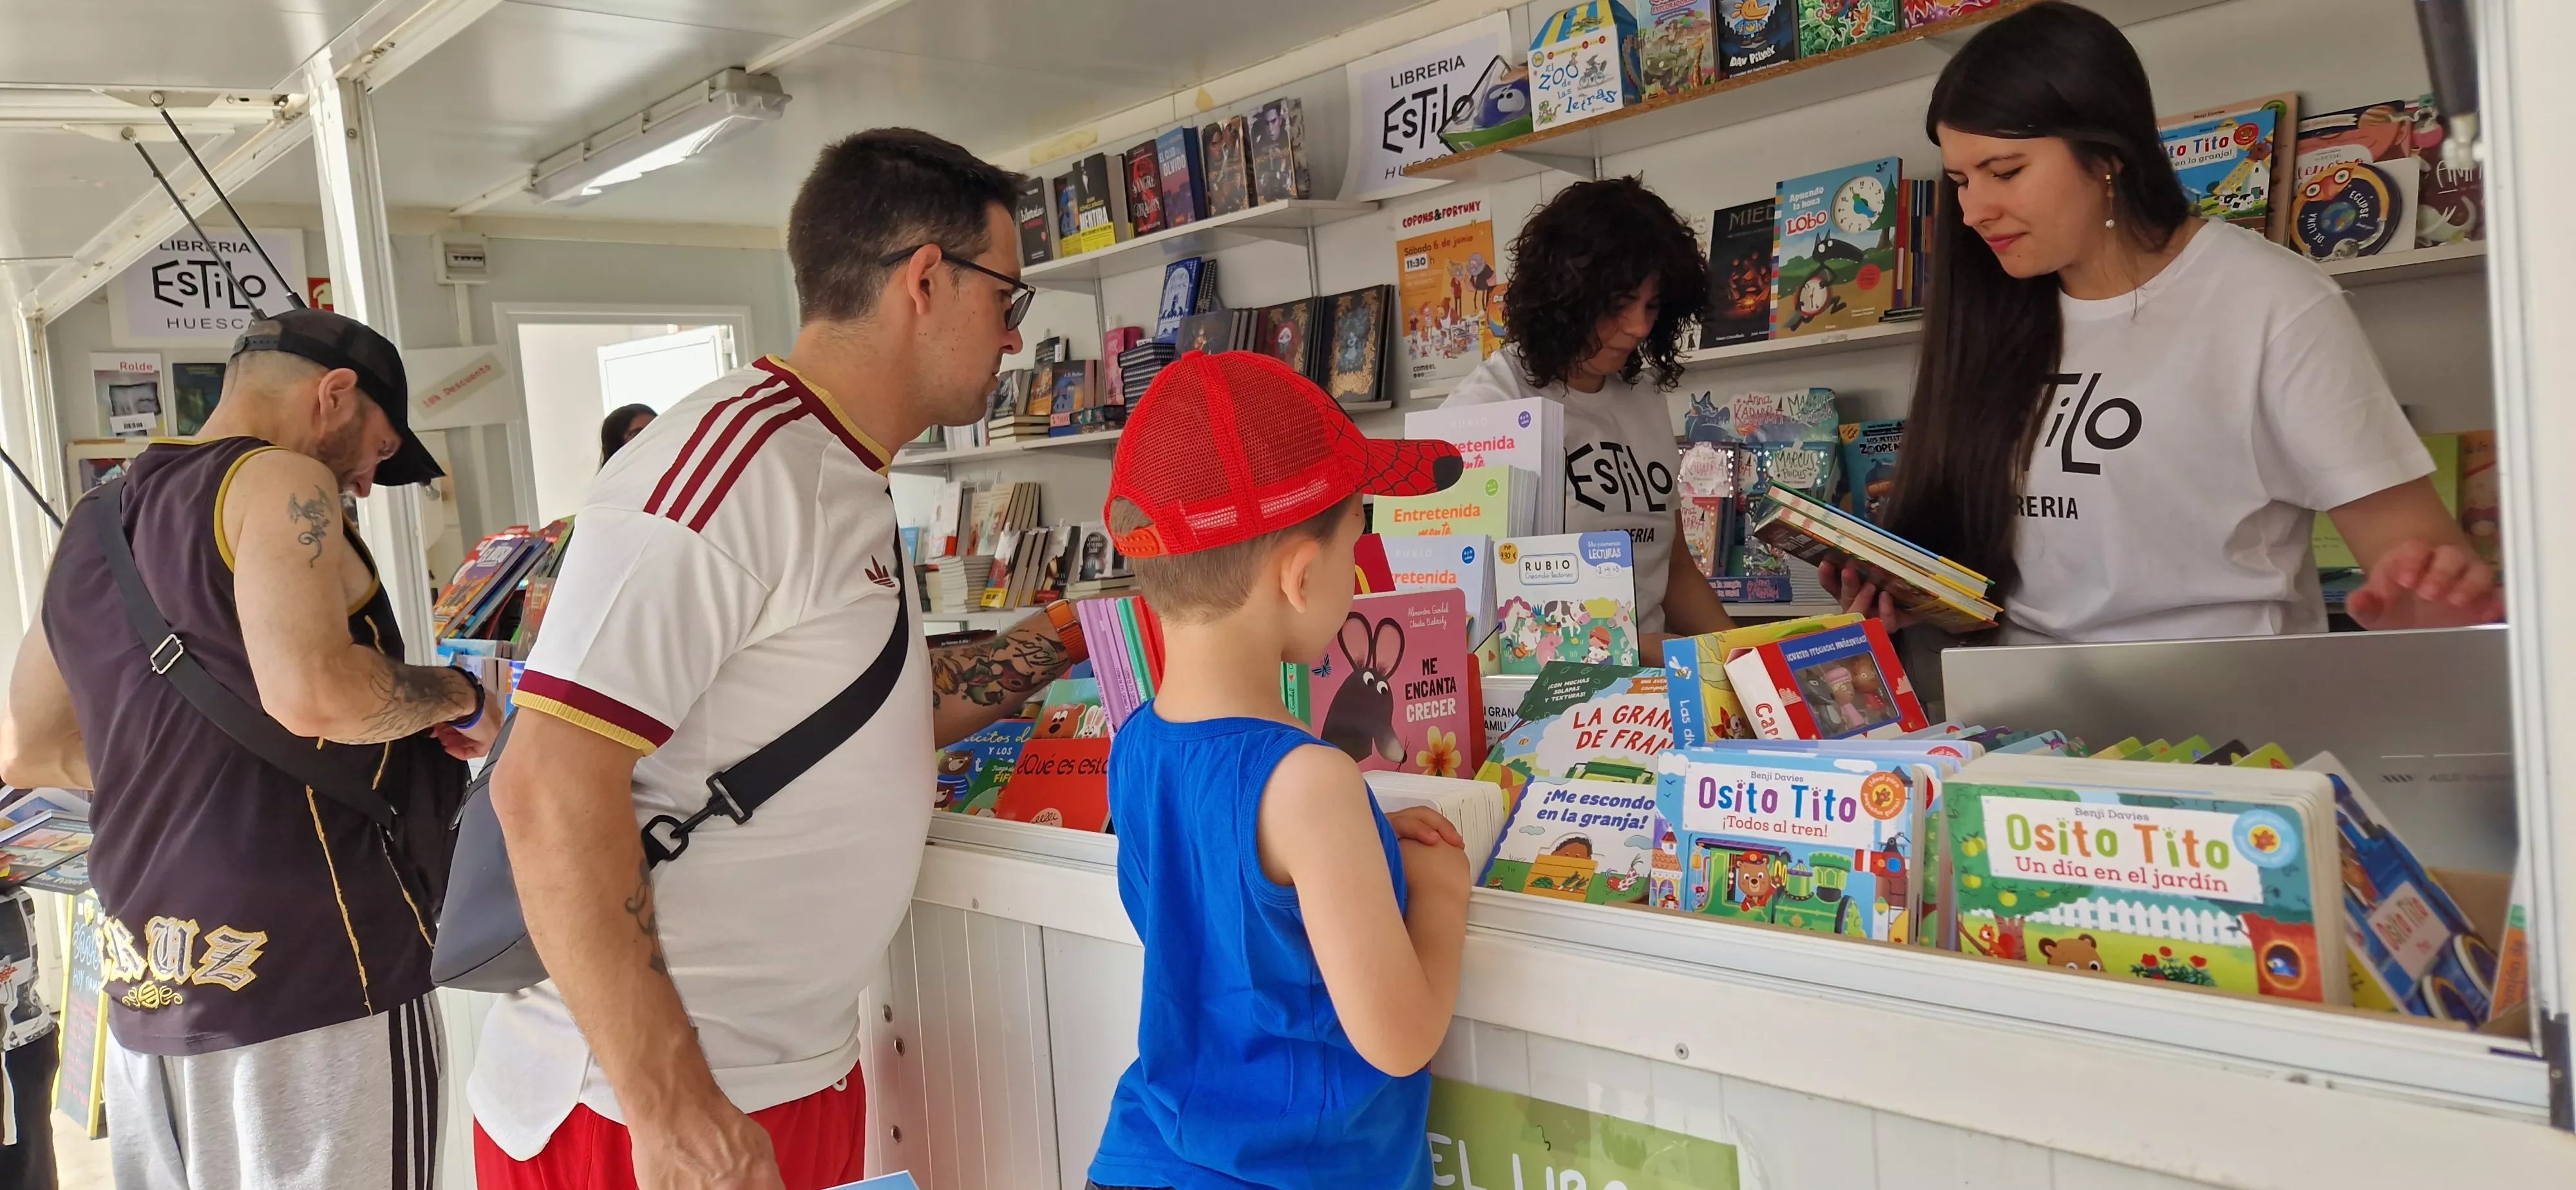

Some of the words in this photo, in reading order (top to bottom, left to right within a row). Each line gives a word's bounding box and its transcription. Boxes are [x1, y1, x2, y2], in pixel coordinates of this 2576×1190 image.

[1546, 63, 1554, 72] El
[1729, 57, 1747, 66] DAV
[1390, 55, 1465, 89] LIBRERIA
[1562, 79, 1571, 87] de
[1557, 88, 1572, 100] las
[1566, 88, 1617, 113] letras
[2193, 136, 2229, 154] Tito
[1163, 155, 1186, 176] OLVIDO
[1789, 187, 1824, 203] Aprendo
[1802, 197, 1820, 207] hora
[2349, 191, 2369, 218] ECLIPSE
[1729, 204, 1775, 231] MIED
[2307, 212, 2318, 234] LUNA
[1404, 243, 1432, 256] Sábado
[1434, 240, 1438, 249] 6
[1442, 238, 1451, 248] de
[1453, 235, 1473, 248] junio
[2313, 232, 2325, 243] DE
[1406, 257, 1426, 269] 11:30
[1429, 256, 1435, 265] h
[120, 361, 153, 372] Rolde
[1746, 393, 1772, 405] Anna
[1457, 435, 1515, 453] etenida
[1859, 442, 1900, 455] ZOOPEN
[1775, 451, 1817, 472] MARCUS
[1394, 503, 1481, 523] Entretenida
[2016, 495, 2079, 520] RERIA
[1683, 510, 1705, 531] ABRA
[1589, 548, 1621, 560] LECTURAS
[1525, 560, 1570, 571] RUBIO
[1393, 569, 1457, 584] retenida
[1422, 657, 1438, 675] ME
[1405, 677, 1457, 700] ENCANTA
[1553, 686, 1580, 695] SOLAPAS
[1564, 677, 1590, 686] MUCHAS
[1551, 692, 1586, 702] TEXTURAS!
[1406, 697, 1456, 722] CRECER
[1573, 707, 1602, 729] LA
[1680, 699, 1690, 724] Las
[1484, 720, 1506, 732] AMILI
[1756, 703, 1783, 740] Cap
[1576, 730, 1608, 750] DE
[1018, 753, 1055, 775] ¿Qué
[1057, 759, 1075, 775] es
[1750, 771, 1772, 781] Benji
[1774, 773, 1804, 783] Davies
[1544, 789, 1577, 804] ¡Me
[1579, 793, 1655, 810] escondo
[1699, 777, 1778, 814] Osito
[1790, 784, 1857, 823] Tito
[1537, 809, 1558, 820] en
[1560, 808, 1578, 823] la
[1578, 812, 1649, 831] granja!
[2074, 807, 2105, 820] Benji
[2109, 808, 2150, 822] Davies
[1722, 815, 1769, 833] ¡Todos
[1774, 820, 1787, 834] al
[1792, 823, 1828, 838] tren!
[2005, 814, 2118, 858] Osito
[2133, 823, 2230, 870] Tito
[2016, 856, 2047, 874] Un
[2054, 859, 2087, 878] día
[2094, 867, 2122, 881] en
[2128, 866, 2148, 883] el
[2152, 871, 2229, 893] jardín
[100, 916, 267, 992] RUZ
